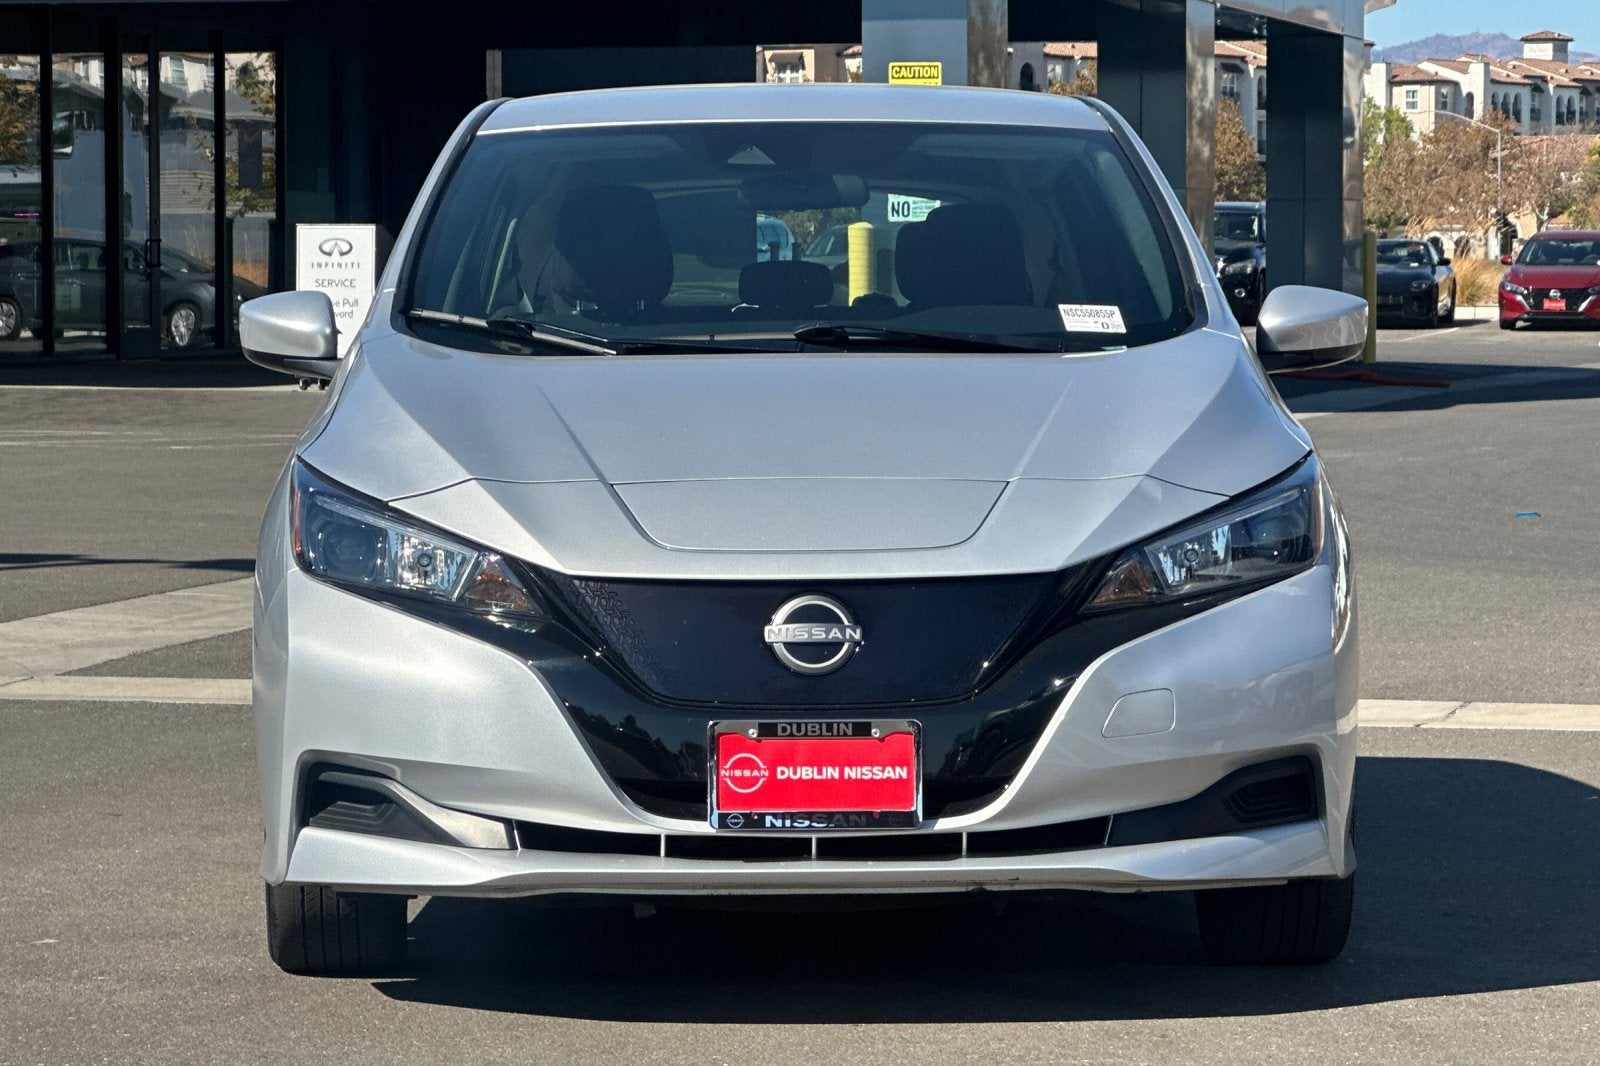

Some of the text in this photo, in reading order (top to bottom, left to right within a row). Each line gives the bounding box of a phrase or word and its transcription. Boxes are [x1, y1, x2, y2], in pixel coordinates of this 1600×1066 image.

[892, 66, 938, 78] CAUTION
[891, 200, 910, 217] NO
[315, 279, 356, 288] SERVICE
[343, 298, 359, 307] Pull
[767, 627, 861, 640] NISSAN
[777, 722, 853, 736] DUBLIN
[721, 769, 769, 777] NISSAN
[777, 766, 908, 779] DUBLIN NISSAN
[765, 813, 866, 827] NISSAN
